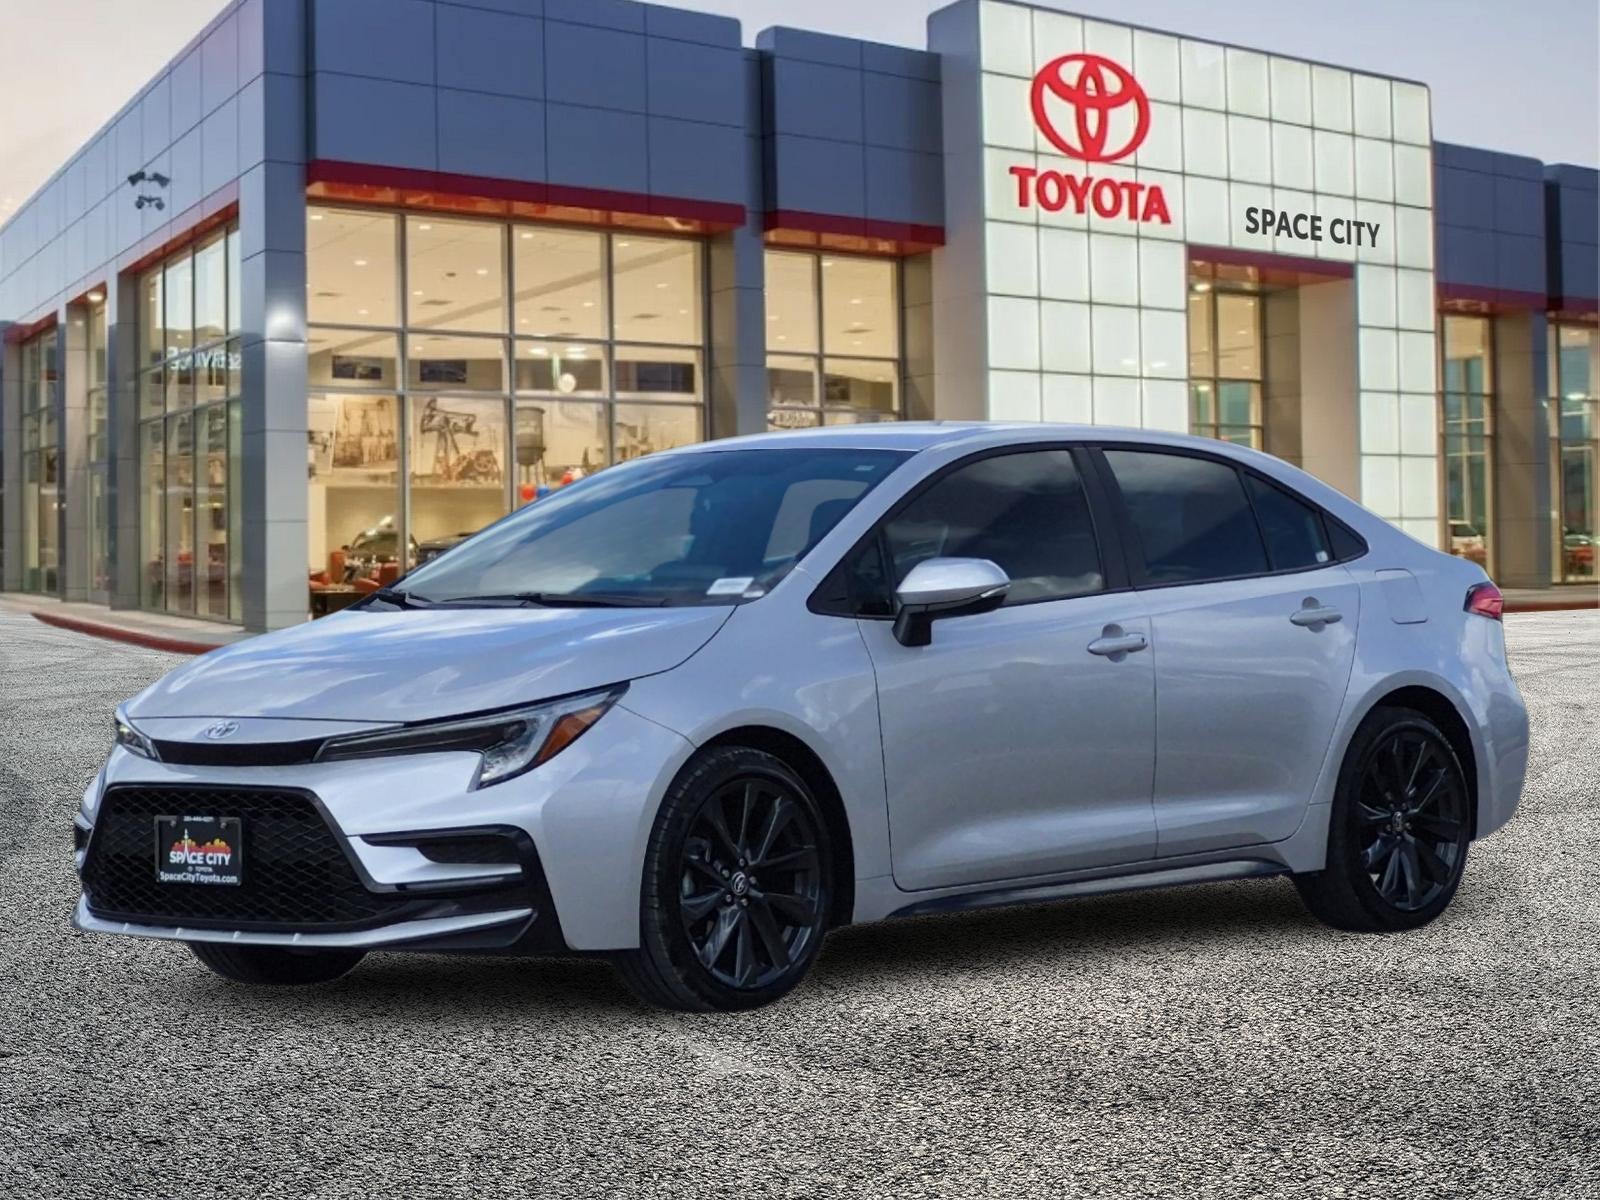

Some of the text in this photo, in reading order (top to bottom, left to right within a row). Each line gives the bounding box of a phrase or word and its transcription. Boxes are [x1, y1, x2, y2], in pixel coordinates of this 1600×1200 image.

[1010, 166, 1171, 224] TOYOTA
[1245, 206, 1380, 248] SPACE CITY
[169, 850, 231, 866] SPACE CITY
[160, 871, 238, 884] SpaceCityToyota.com
